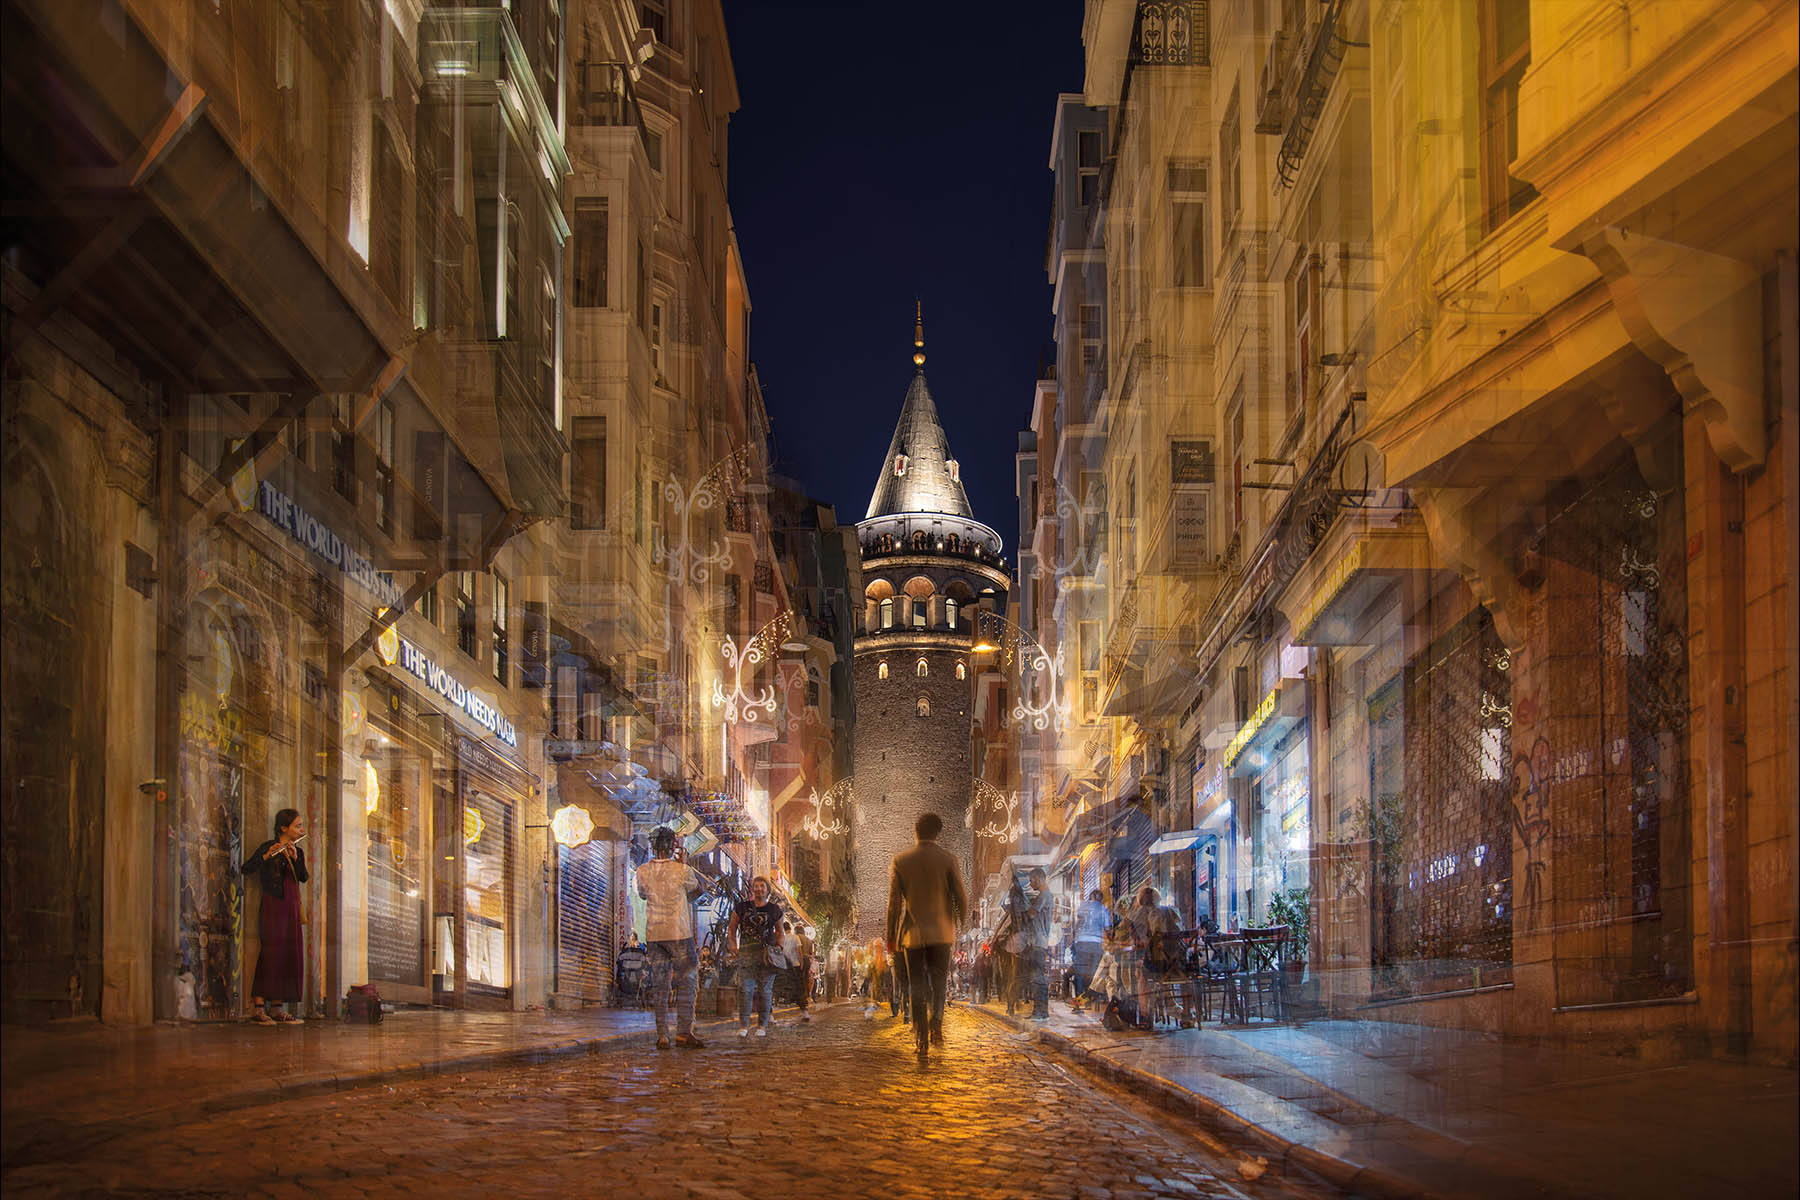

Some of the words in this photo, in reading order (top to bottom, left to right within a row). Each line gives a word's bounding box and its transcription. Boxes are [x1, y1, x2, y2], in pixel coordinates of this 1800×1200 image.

[262, 480, 292, 530] THE
[294, 505, 342, 566] WORLD
[531, 630, 539, 658] GENOVA
[402, 640, 426, 680] THE
[426, 659, 466, 708] WORLD
[465, 690, 496, 732] NEEDS
[495, 713, 517, 748] NATA
